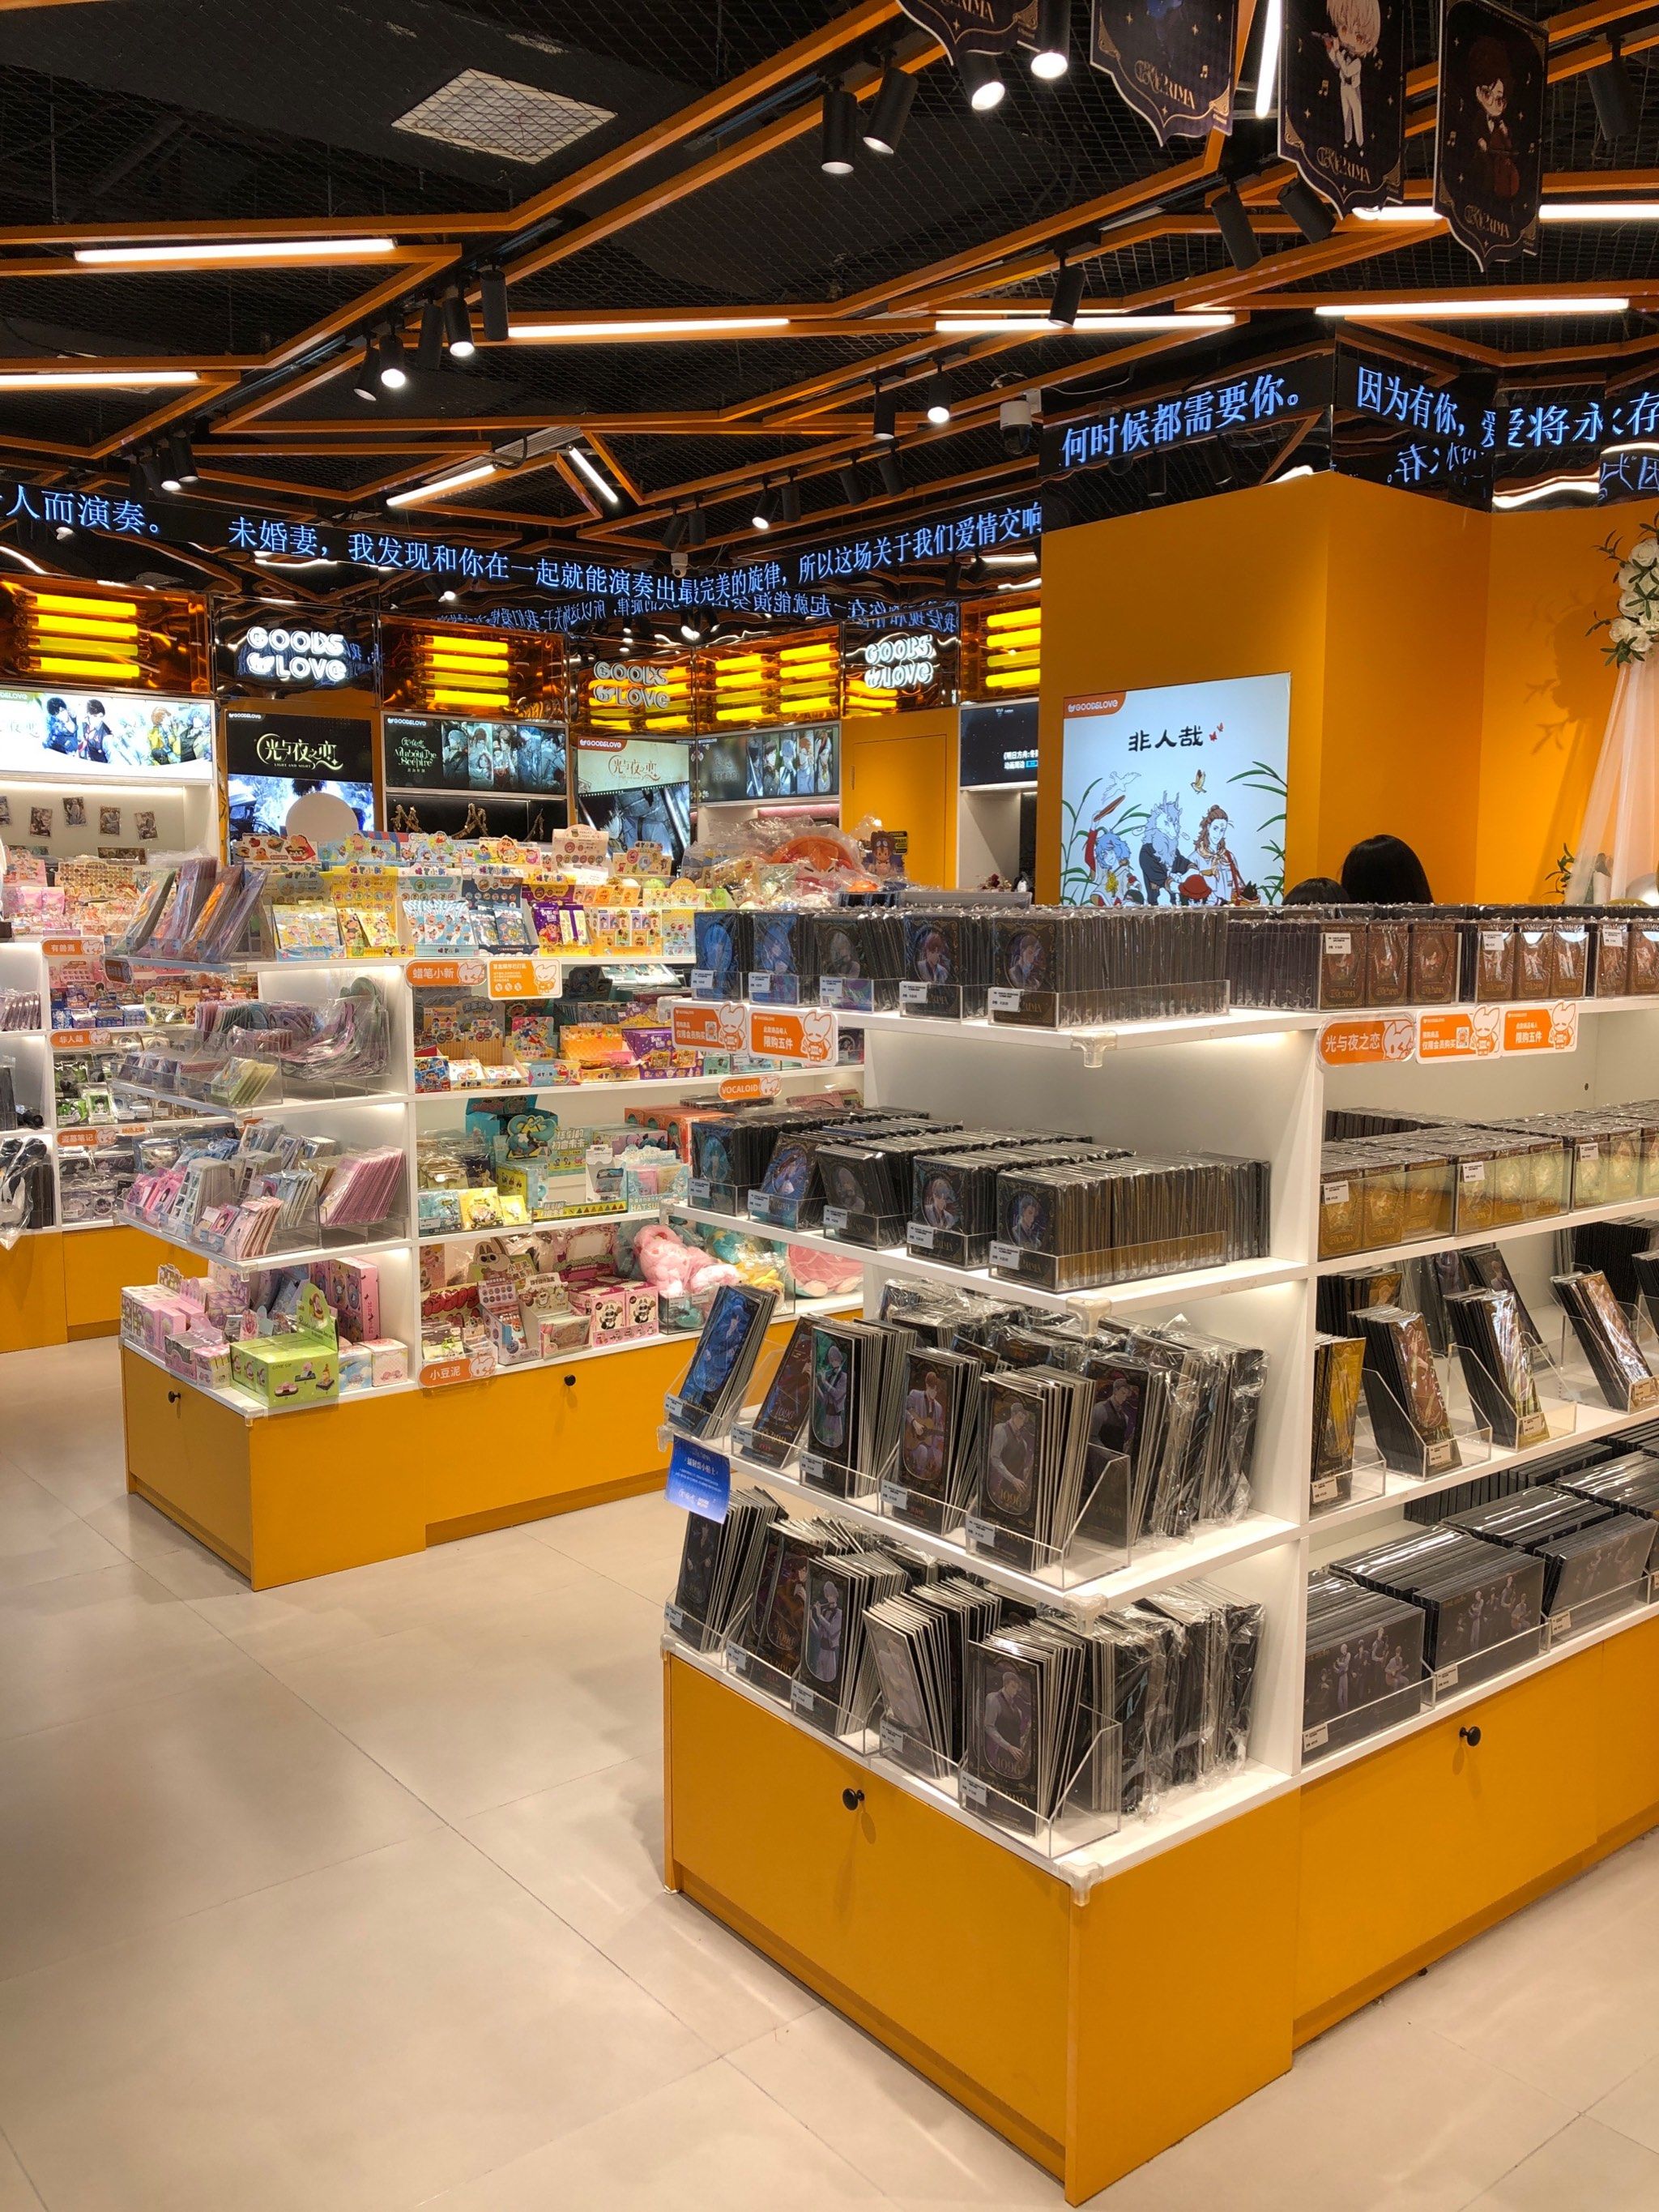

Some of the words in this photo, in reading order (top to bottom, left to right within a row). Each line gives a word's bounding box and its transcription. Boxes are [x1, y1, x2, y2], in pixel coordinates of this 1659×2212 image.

[1062, 374, 1299, 468] 何时候都需要你。
[0, 485, 160, 534] 人而演奏。
[246, 626, 344, 656] GOODS
[865, 634, 933, 664] GOODS
[275, 655, 347, 682] LOVE
[594, 661, 670, 686] GOODS
[882, 661, 934, 689] LOVE
[615, 687, 671, 709] LOVE
[1075, 699, 1119, 711] GOODSLOVE
[586, 740, 622, 749] GOODSLOVE
[1128, 725, 1204, 752] 非人哉
[257, 733, 344, 771] 光与夜之恋
[412, 967, 454, 980] 蜡笔小新
[676, 1029, 706, 1040] 仅限会员购买
[763, 1036, 794, 1050] 限购五件
[1325, 1032, 1381, 1053] 光与夜之恋
[1422, 1039, 1456, 1051] 仅限会员购买
[1515, 1031, 1543, 1044] 限购五件
[721, 1083, 758, 1095] VOCALOID
[429, 1364, 461, 1380] 小豆泥
